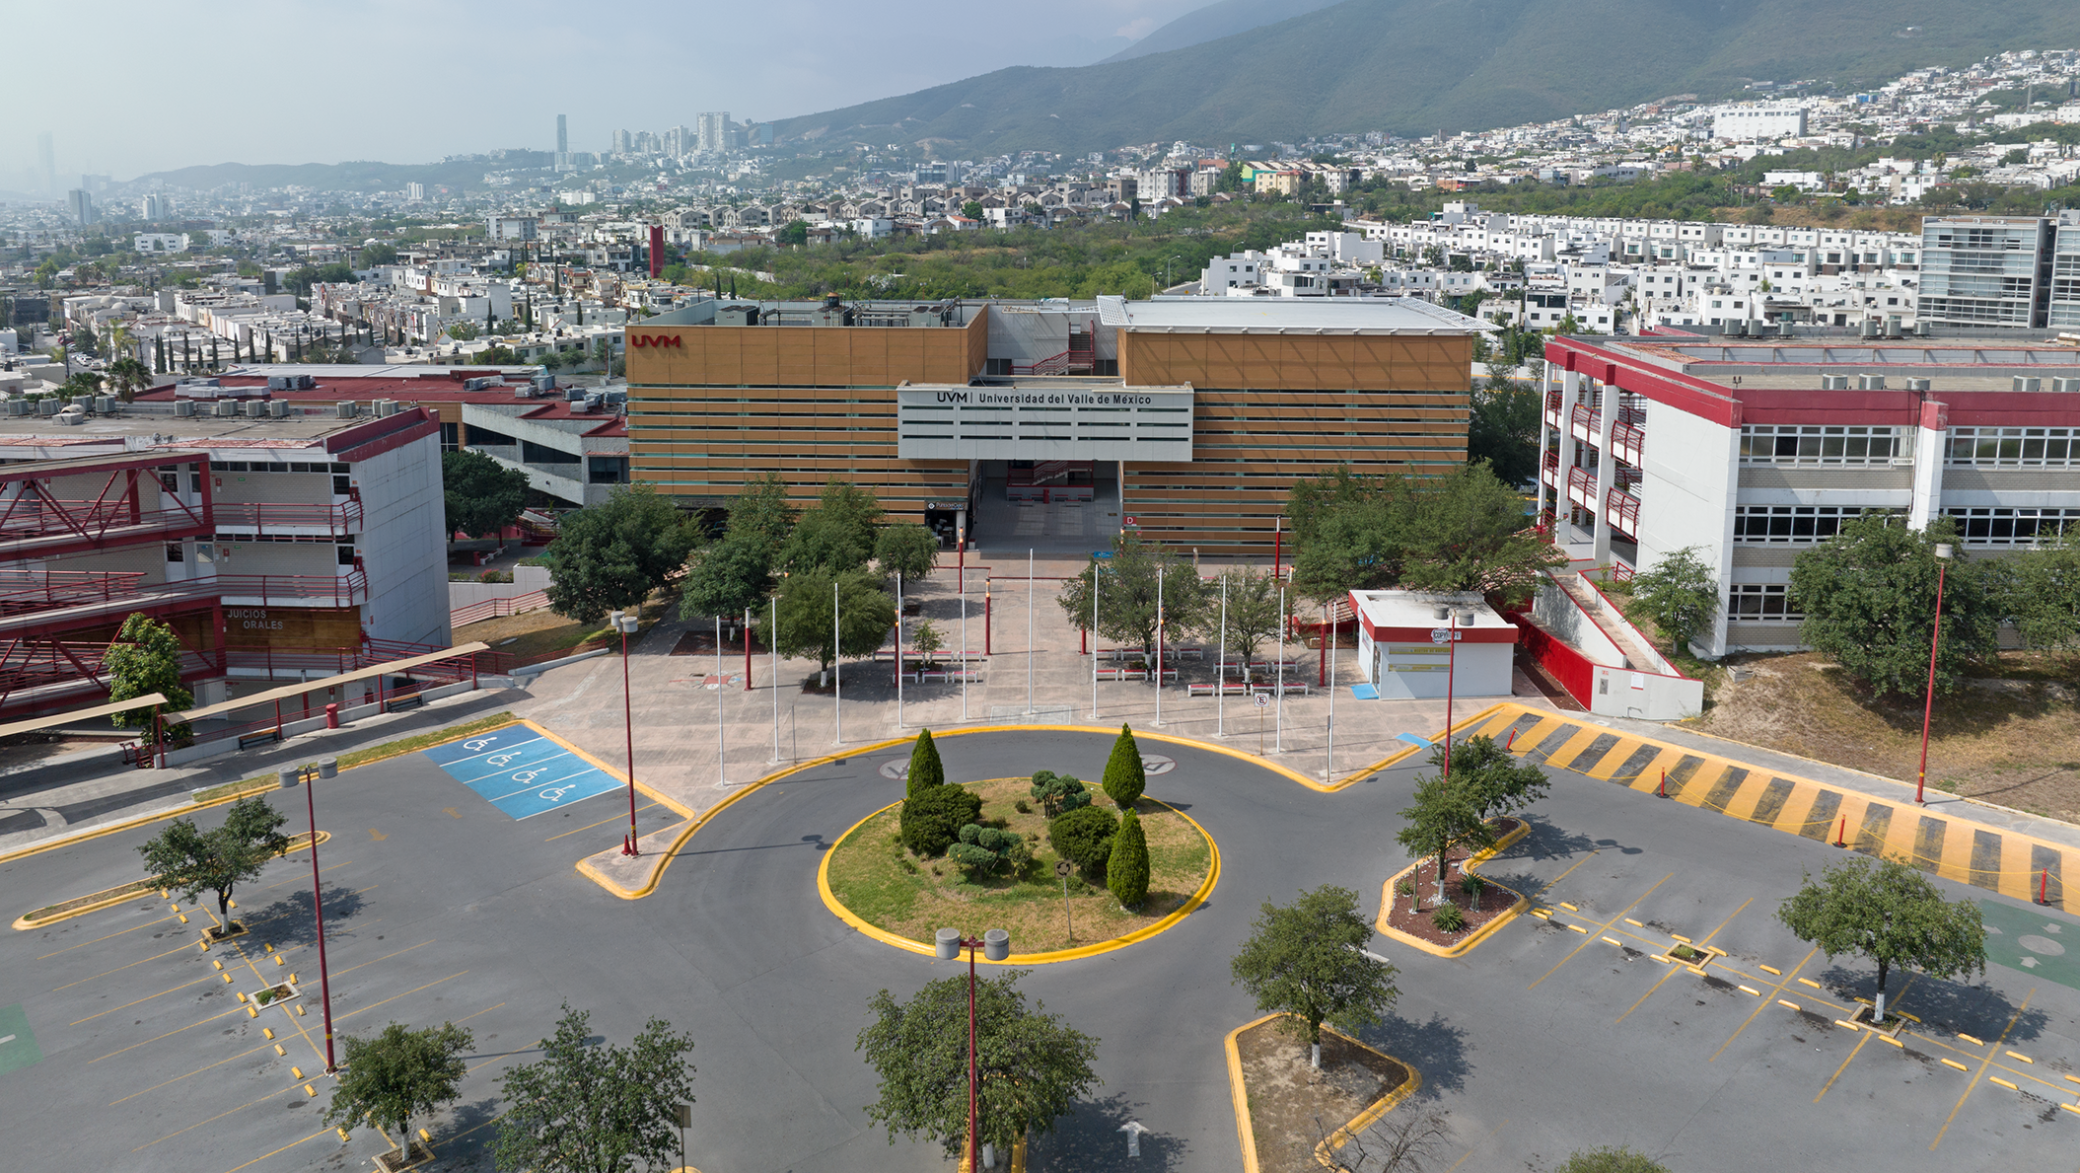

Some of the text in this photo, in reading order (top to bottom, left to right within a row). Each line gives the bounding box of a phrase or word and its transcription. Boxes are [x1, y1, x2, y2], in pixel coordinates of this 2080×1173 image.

[631, 334, 681, 348] UVM
[937, 392, 1151, 404] UVM Universidad del Valle de México
[228, 609, 267, 619] JUICIOS
[243, 620, 283, 630] ORALES
